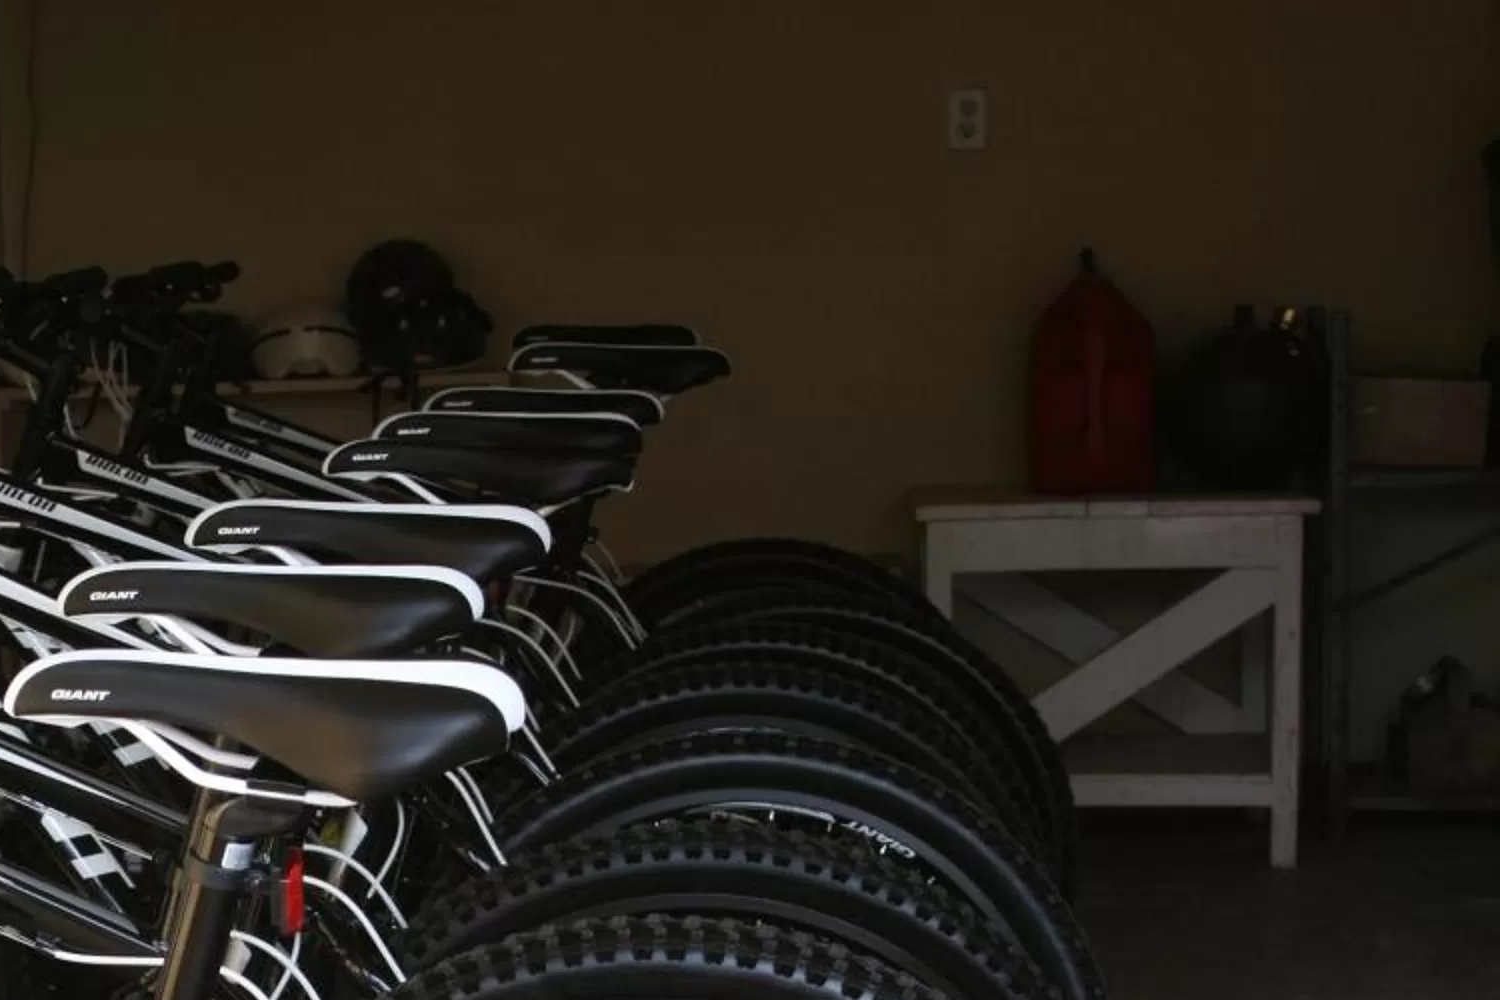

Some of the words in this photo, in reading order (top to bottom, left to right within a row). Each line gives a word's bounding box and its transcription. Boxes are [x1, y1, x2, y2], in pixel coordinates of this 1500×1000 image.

[217, 526, 260, 535] GIANT
[89, 591, 139, 601] GIANT
[51, 688, 110, 701] GIANT
